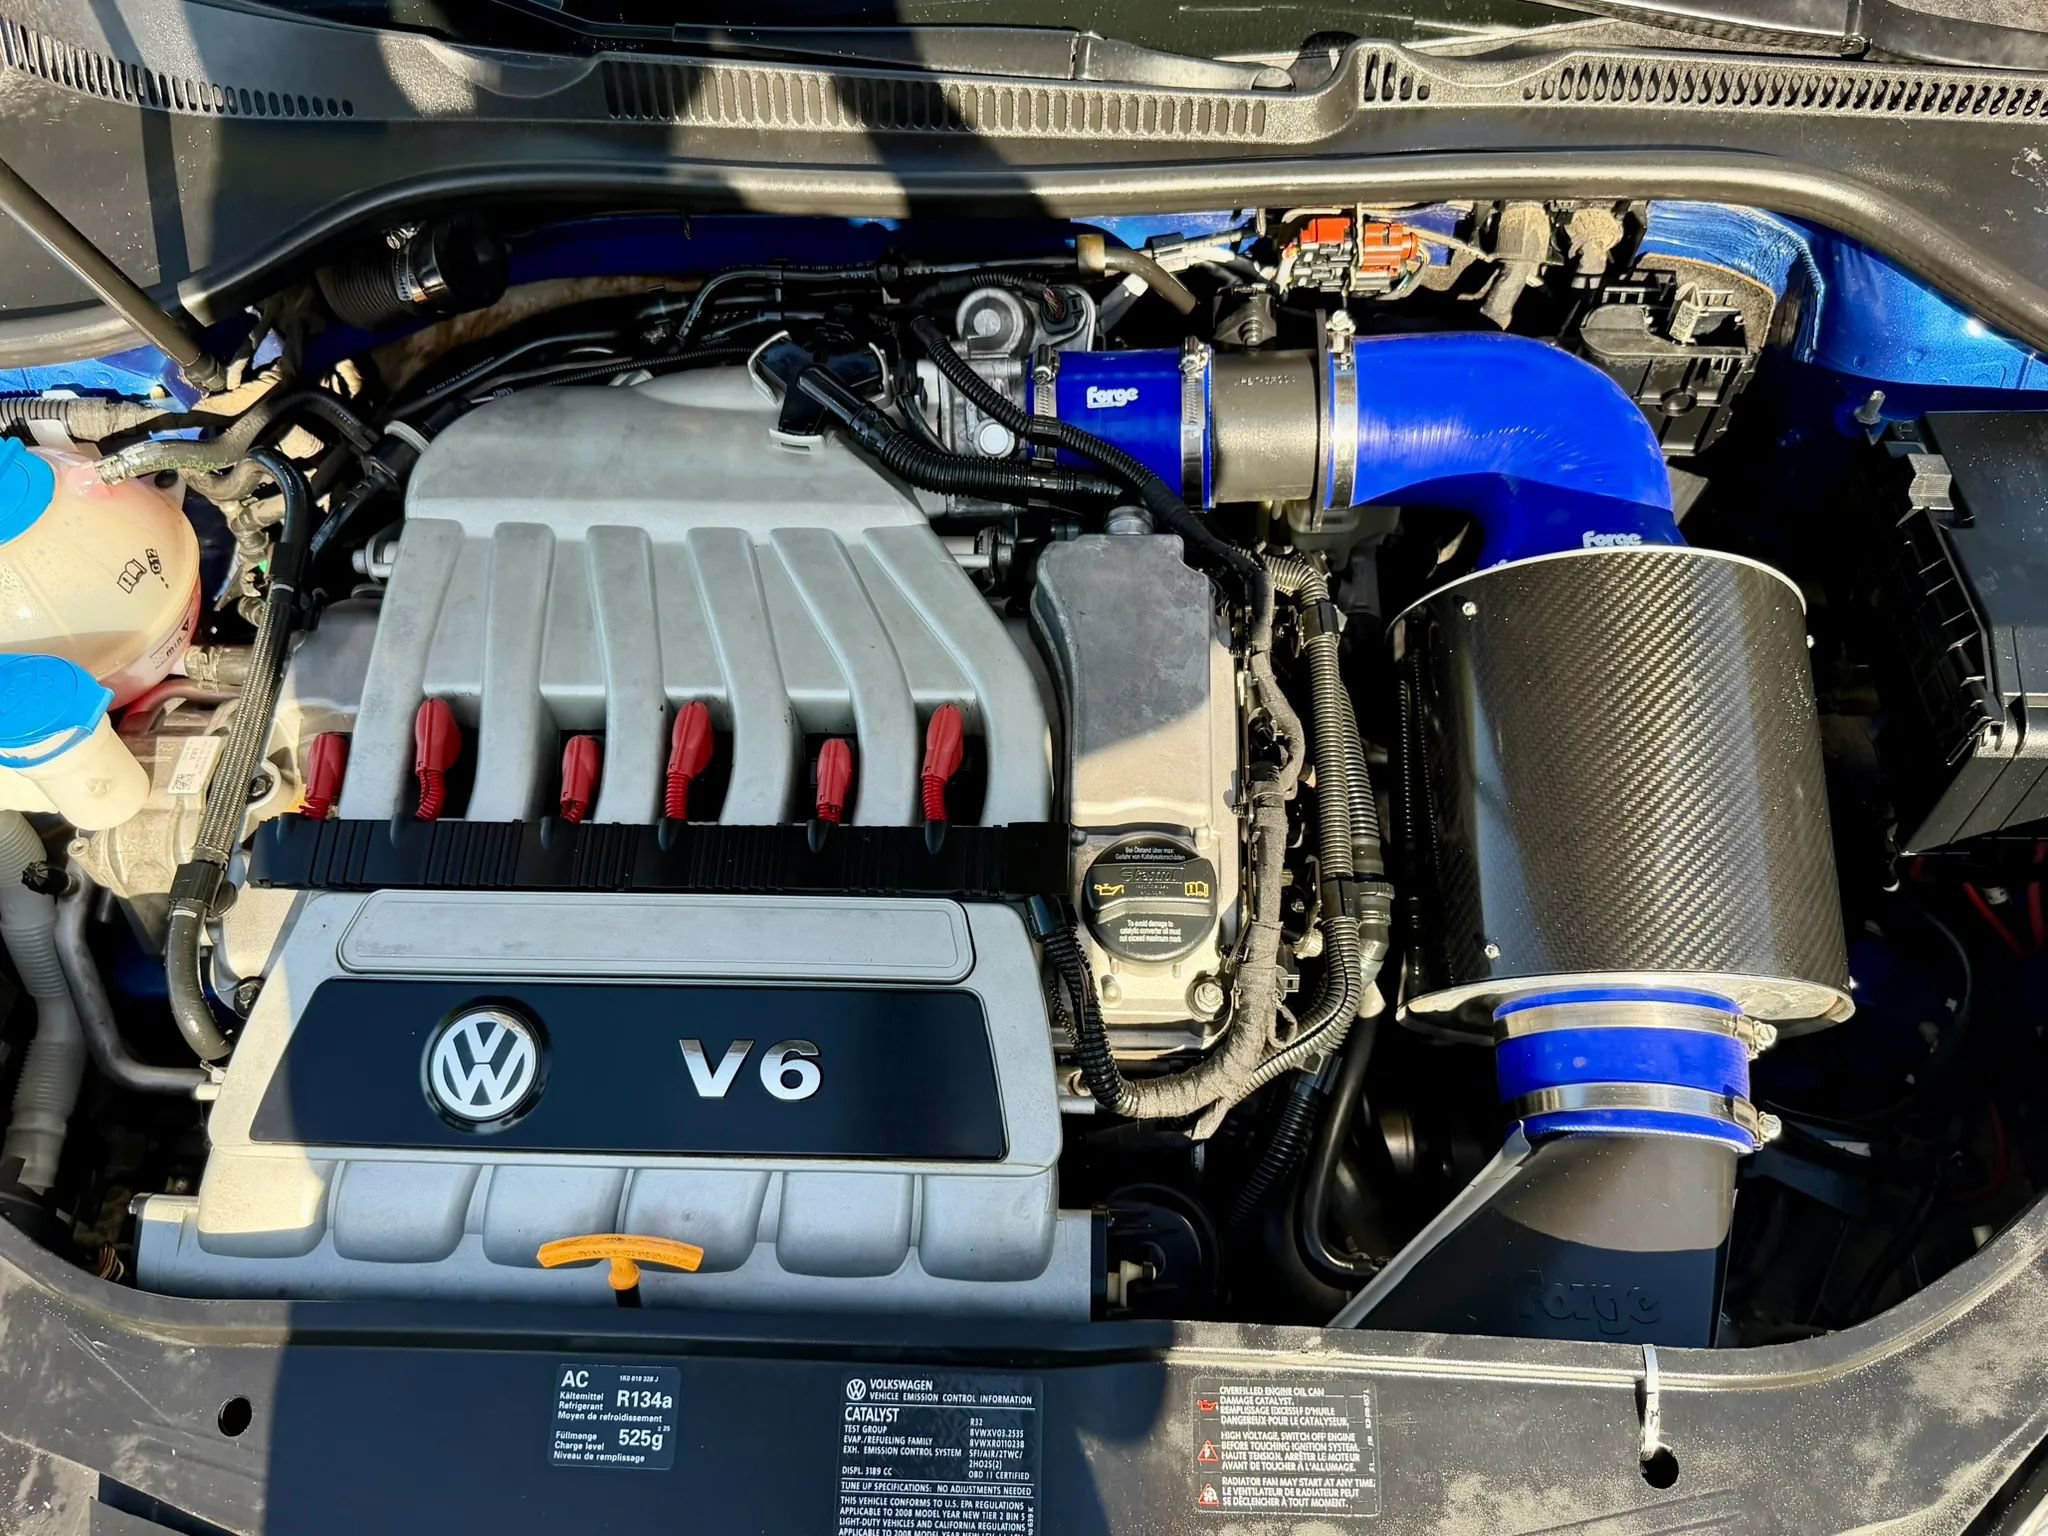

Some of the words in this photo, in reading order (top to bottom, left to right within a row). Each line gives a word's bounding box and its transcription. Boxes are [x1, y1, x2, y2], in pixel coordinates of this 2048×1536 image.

[166, 636, 183, 655] min
[679, 1038, 822, 1100] V6
[561, 1370, 589, 1387] AC
[870, 1379, 933, 1390] VOLKSWAGEN
[560, 1392, 604, 1400] Kältemittel
[1220, 1386, 1263, 1395] OVERFILLED
[1264, 1387, 1292, 1395] ENGINE
[1293, 1387, 1307, 1396] OIL
[1308, 1388, 1324, 1396] CAN
[616, 1390, 673, 1408] R134a
[870, 1392, 899, 1400] VEHICLE
[902, 1393, 938, 1401] EMISSION
[942, 1394, 976, 1402] CONTROL
[979, 1395, 1032, 1404] INFORMATION
[1220, 1396, 1253, 1405] DAMAGE
[1254, 1397, 1294, 1406] CATALYST.
[559, 1401, 603, 1410] Refrigerant
[845, 1407, 900, 1422] CATALYST
[1220, 1406, 1269, 1415] REMPLISSAGE
[1304, 1408, 1335, 1416] D'HUILE
[558, 1411, 585, 1420] Moyen
[599, 1413, 662, 1423] refroidissement
[970, 1418, 983, 1426] R32
[1220, 1416, 1266, 1425] DANGEREUX
[1268, 1417, 1288, 1425] POUR
[1289, 1417, 1298, 1426] LE
[844, 1425, 859, 1433] TEST
[556, 1431, 597, 1440] Füllmenge
[619, 1429, 663, 1450] 525g
[844, 1436, 905, 1445] EVAP./REFUELING
[907, 1437, 933, 1445] FAMILY
[1221, 1432, 1241, 1440] HIGH
[1280, 1432, 1309, 1440] SWITCH
[1310, 1432, 1325, 1441] OFF
[1327, 1433, 1355, 1441] ENGINE
[554, 1441, 582, 1449] Charge
[585, 1442, 604, 1450] level
[1221, 1442, 1248, 1450] BEFORE
[1250, 1442, 1289, 1450] TOUCHING
[1291, 1442, 1326, 1451] IGNITION
[843, 1446, 859, 1454] EXH.
[863, 1447, 898, 1455] EMISSION
[900, 1447, 932, 1456] CONTROL
[934, 1448, 962, 1456] SYSTEM
[554, 1451, 581, 1460] Niveau
[583, 1453, 593, 1461] de
[596, 1453, 645, 1463] remplissage
[1221, 1452, 1246, 1460] HAUTE
[1317, 1453, 1326, 1461] LE
[1327, 1453, 1360, 1461] MOTEUR
[842, 1466, 862, 1474] DISPL.
[865, 1467, 880, 1475] 3189
[1222, 1462, 1247, 1470] AVANT
[1249, 1462, 1260, 1470] DE
[1261, 1462, 1295, 1471] TOUCHER
[1304, 1463, 1356, 1471] L'ALLUMAGE.
[968, 1471, 983, 1479] OBD
[995, 1472, 1030, 1480] CERTIFIED
[1222, 1477, 1260, 1486] RADIATOR
[1262, 1478, 1278, 1486] FAN
[1279, 1478, 1297, 1486] MAY
[1298, 1478, 1322, 1487] START
[1323, 1478, 1334, 1487] AT
[1336, 1478, 1352, 1487] ANY
[841, 1482, 860, 1490] TUNE
[862, 1482, 871, 1490] UP
[874, 1483, 931, 1492] SPECIFICATIONS:
[936, 1485, 948, 1493] NO
[950, 1485, 1001, 1494] ADJUSTMENTS
[1003, 1487, 1031, 1495] NEEDED
[1222, 1488, 1231, 1496] LE
[1233, 1488, 1282, 1496] VENTILATEUR
[1284, 1488, 1294, 1496] DE
[1295, 1488, 1338, 1497] RADIATEUR
[1340, 1489, 1359, 1497] PEUT
[841, 1496, 856, 1505] THIS
[858, 1497, 888, 1506] VEHICLE
[889, 1498, 930, 1507] CONFORMS
[933, 1499, 942, 1507] TO
[944, 1499, 958, 1508] U.S.
[960, 1500, 972, 1508] EPA
[974, 1500, 1024, 1510] REGULATIONS
[1223, 1498, 1231, 1506] SE
[1288, 1498, 1308, 1507] TOUT
[1310, 1499, 1349, 1507] MOMENT.
[840, 1507, 881, 1516] APPLICABLE
[883, 1509, 892, 1517] TO
[895, 1509, 912, 1518] 2008
[914, 1510, 939, 1518] MODEL
[942, 1510, 960, 1519] YEAR
[962, 1511, 979, 1520] NEW
[982, 1512, 996, 1520] TIER
[999, 1512, 1003, 1520] 2
[1005, 1512, 1018, 1521] BIN
[1021, 1513, 1025, 1521] 5
[839, 1518, 880, 1527] LIGHT-DUTY
[882, 1519, 914, 1528] VEHICLES
[916, 1520, 932, 1528] AND
[934, 1521, 975, 1530] CALIFORNIA
[977, 1522, 1026, 1531] REGULATIONS
